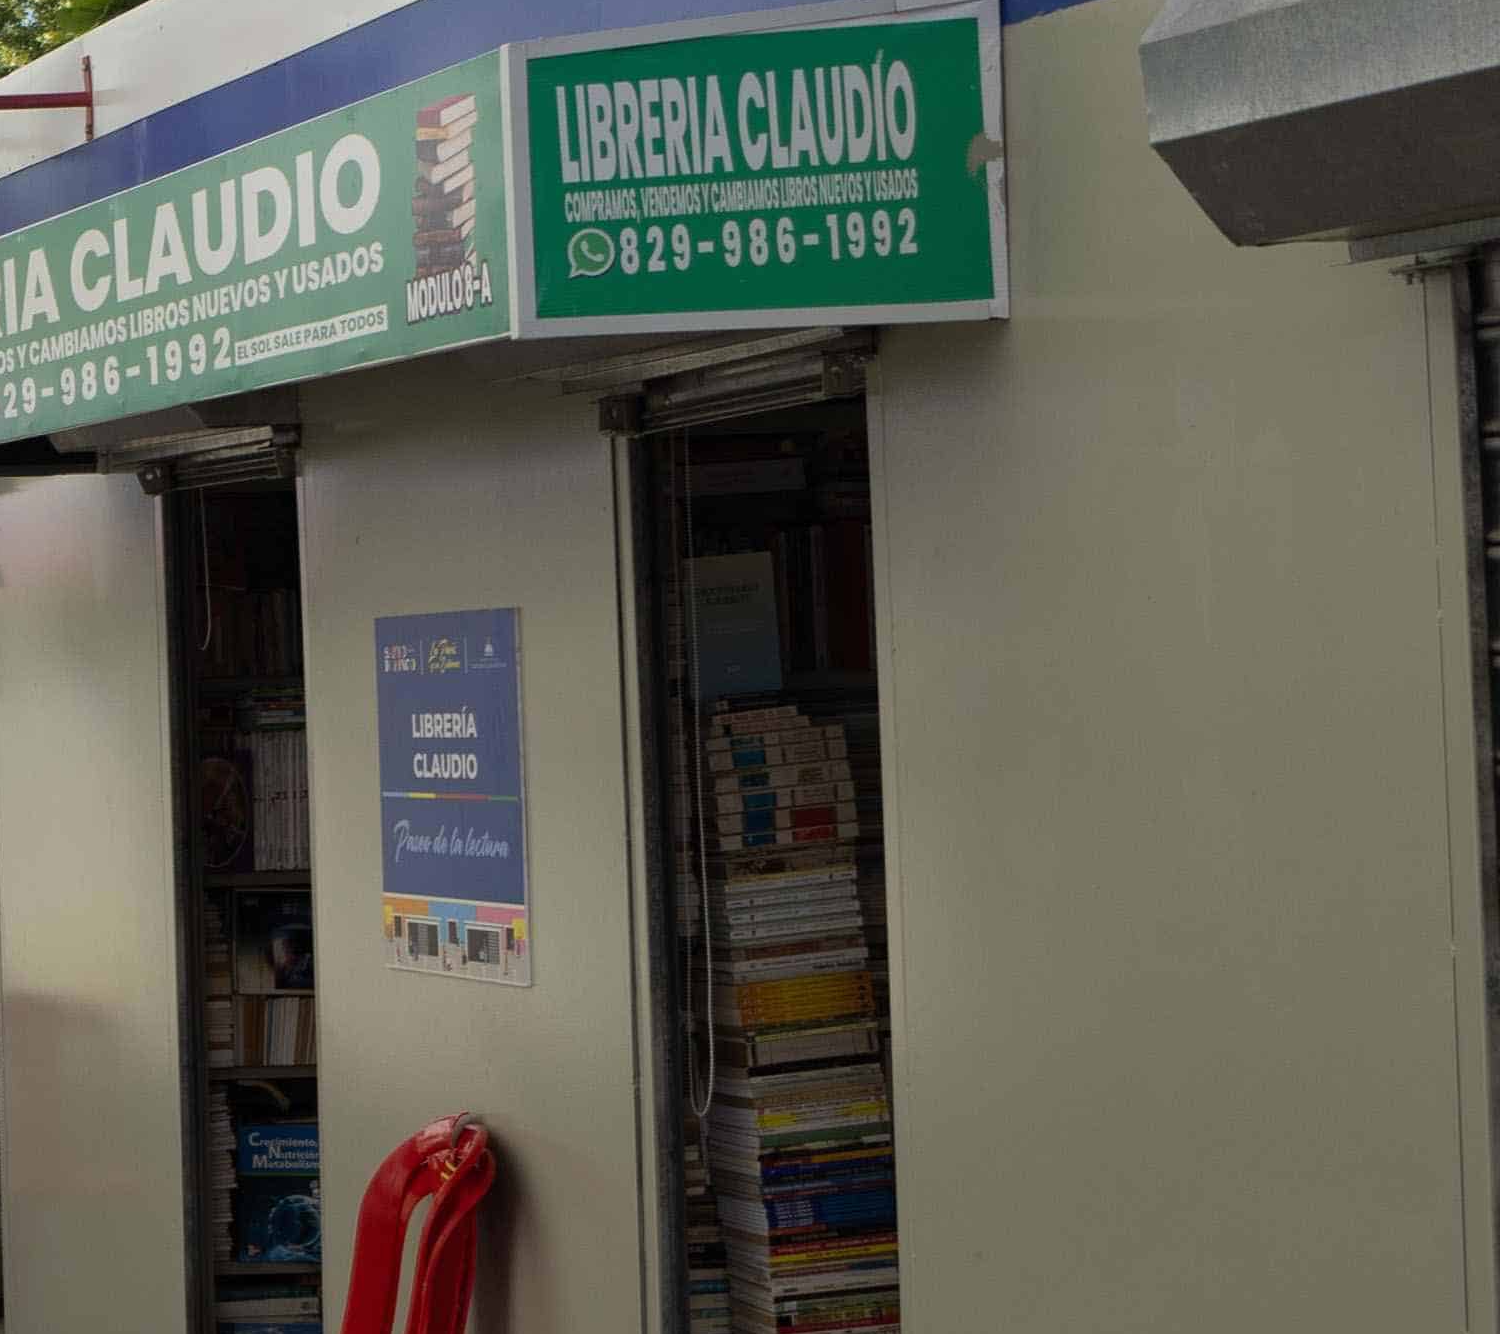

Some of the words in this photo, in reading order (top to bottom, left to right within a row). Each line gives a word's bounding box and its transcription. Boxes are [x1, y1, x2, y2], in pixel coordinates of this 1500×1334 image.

[555, 73, 732, 184] LIBRERIA
[641, 184, 701, 218] VENDEMOS
[700, 184, 711, 214] Y
[711, 177, 779, 212] CAMBIAMOS
[779, 174, 818, 208] LIBROS
[818, 171, 862, 205] NUEVOS
[861, 171, 872, 202] Y
[872, 167, 919, 201] USADOS
[70, 133, 381, 314] CLAUDIO
[16, 348, 29, 369] Y
[29, 316, 127, 366] CAMBIAMOS
[128, 297, 191, 339] LIBROS
[192, 277, 272, 323] NUEVOS
[274, 269, 289, 299] Y
[290, 241, 385, 295] USADOS
[250, 338, 271, 357] SOL
[271, 330, 303, 351] SALE
[303, 322, 338, 344] PARA
[338, 310, 386, 335] TODOS
[411, 706, 478, 740] LIBRERÍA
[413, 752, 479, 780] CLAUDIO
